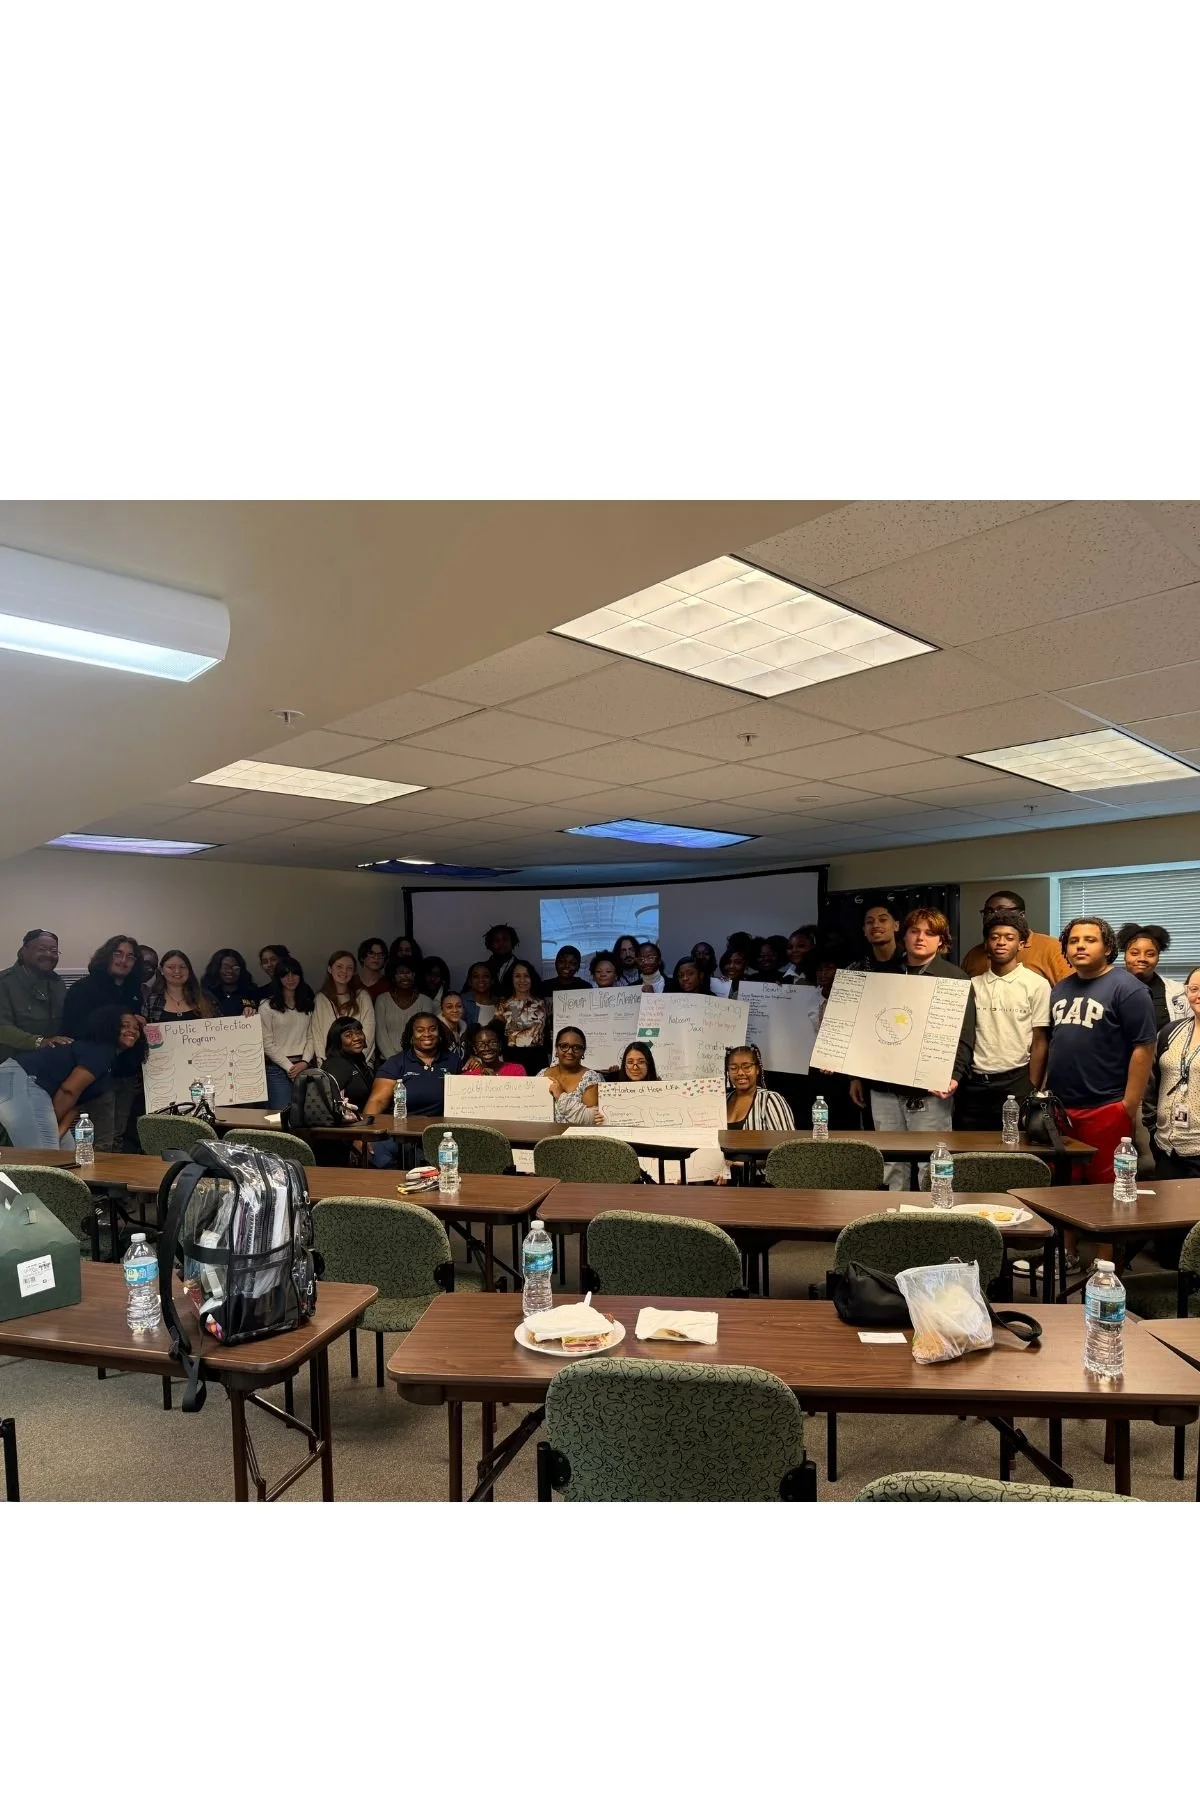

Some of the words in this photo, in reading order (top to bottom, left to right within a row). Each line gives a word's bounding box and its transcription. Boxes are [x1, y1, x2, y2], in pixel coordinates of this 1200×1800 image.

[557, 994, 587, 1012] Your
[588, 991, 616, 1011] Life
[1052, 996, 1105, 1029] GAP
[164, 1024, 197, 1035] Public
[204, 1020, 252, 1032] Protection
[182, 1035, 216, 1045] Program
